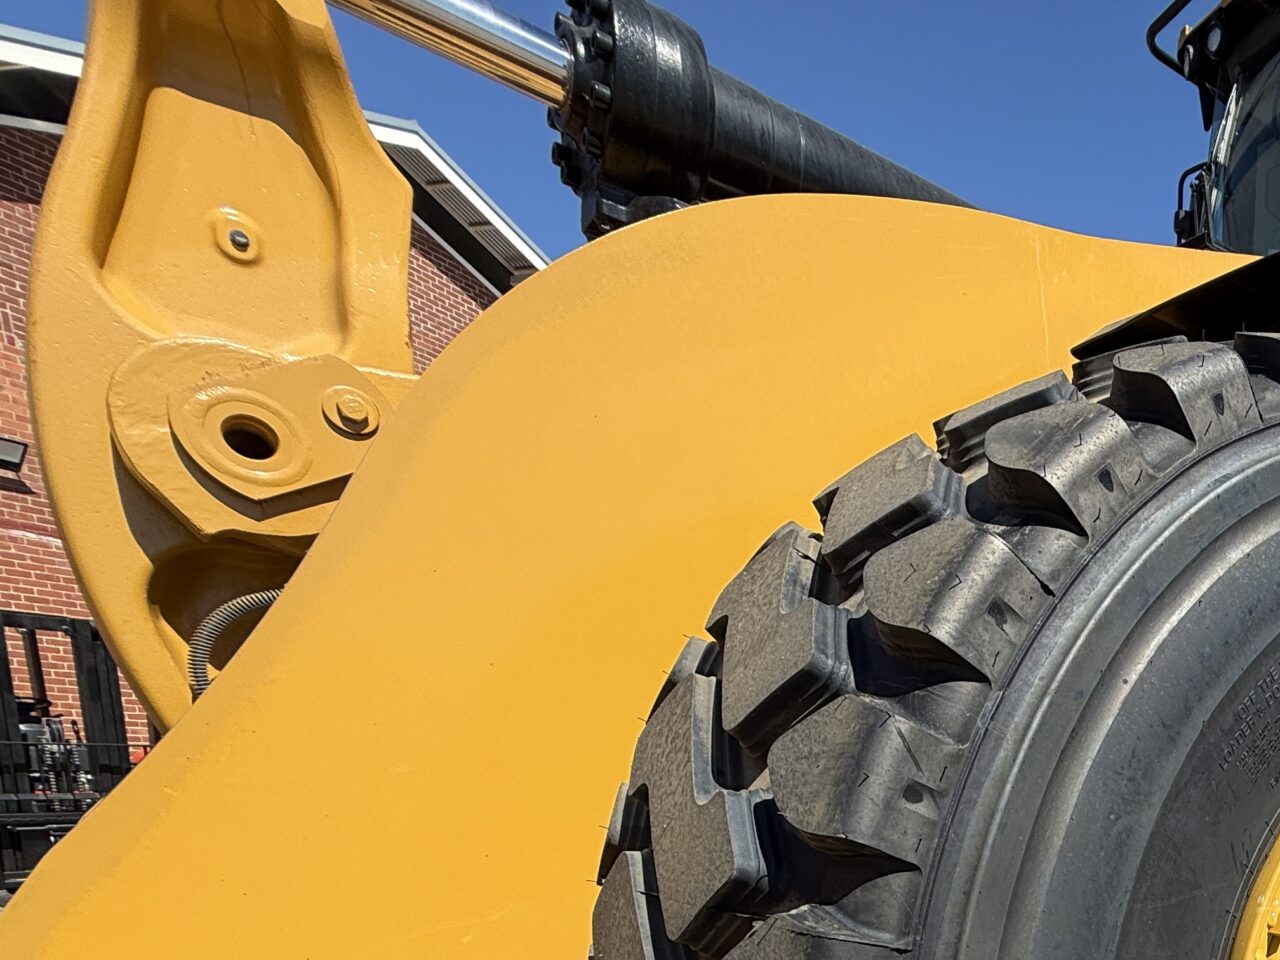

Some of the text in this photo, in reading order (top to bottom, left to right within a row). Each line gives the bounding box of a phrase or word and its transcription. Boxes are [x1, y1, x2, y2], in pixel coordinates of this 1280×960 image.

[1237, 690, 1257, 720] OFF
[1257, 665, 1279, 694] THE
[1218, 716, 1256, 771] LOADER
